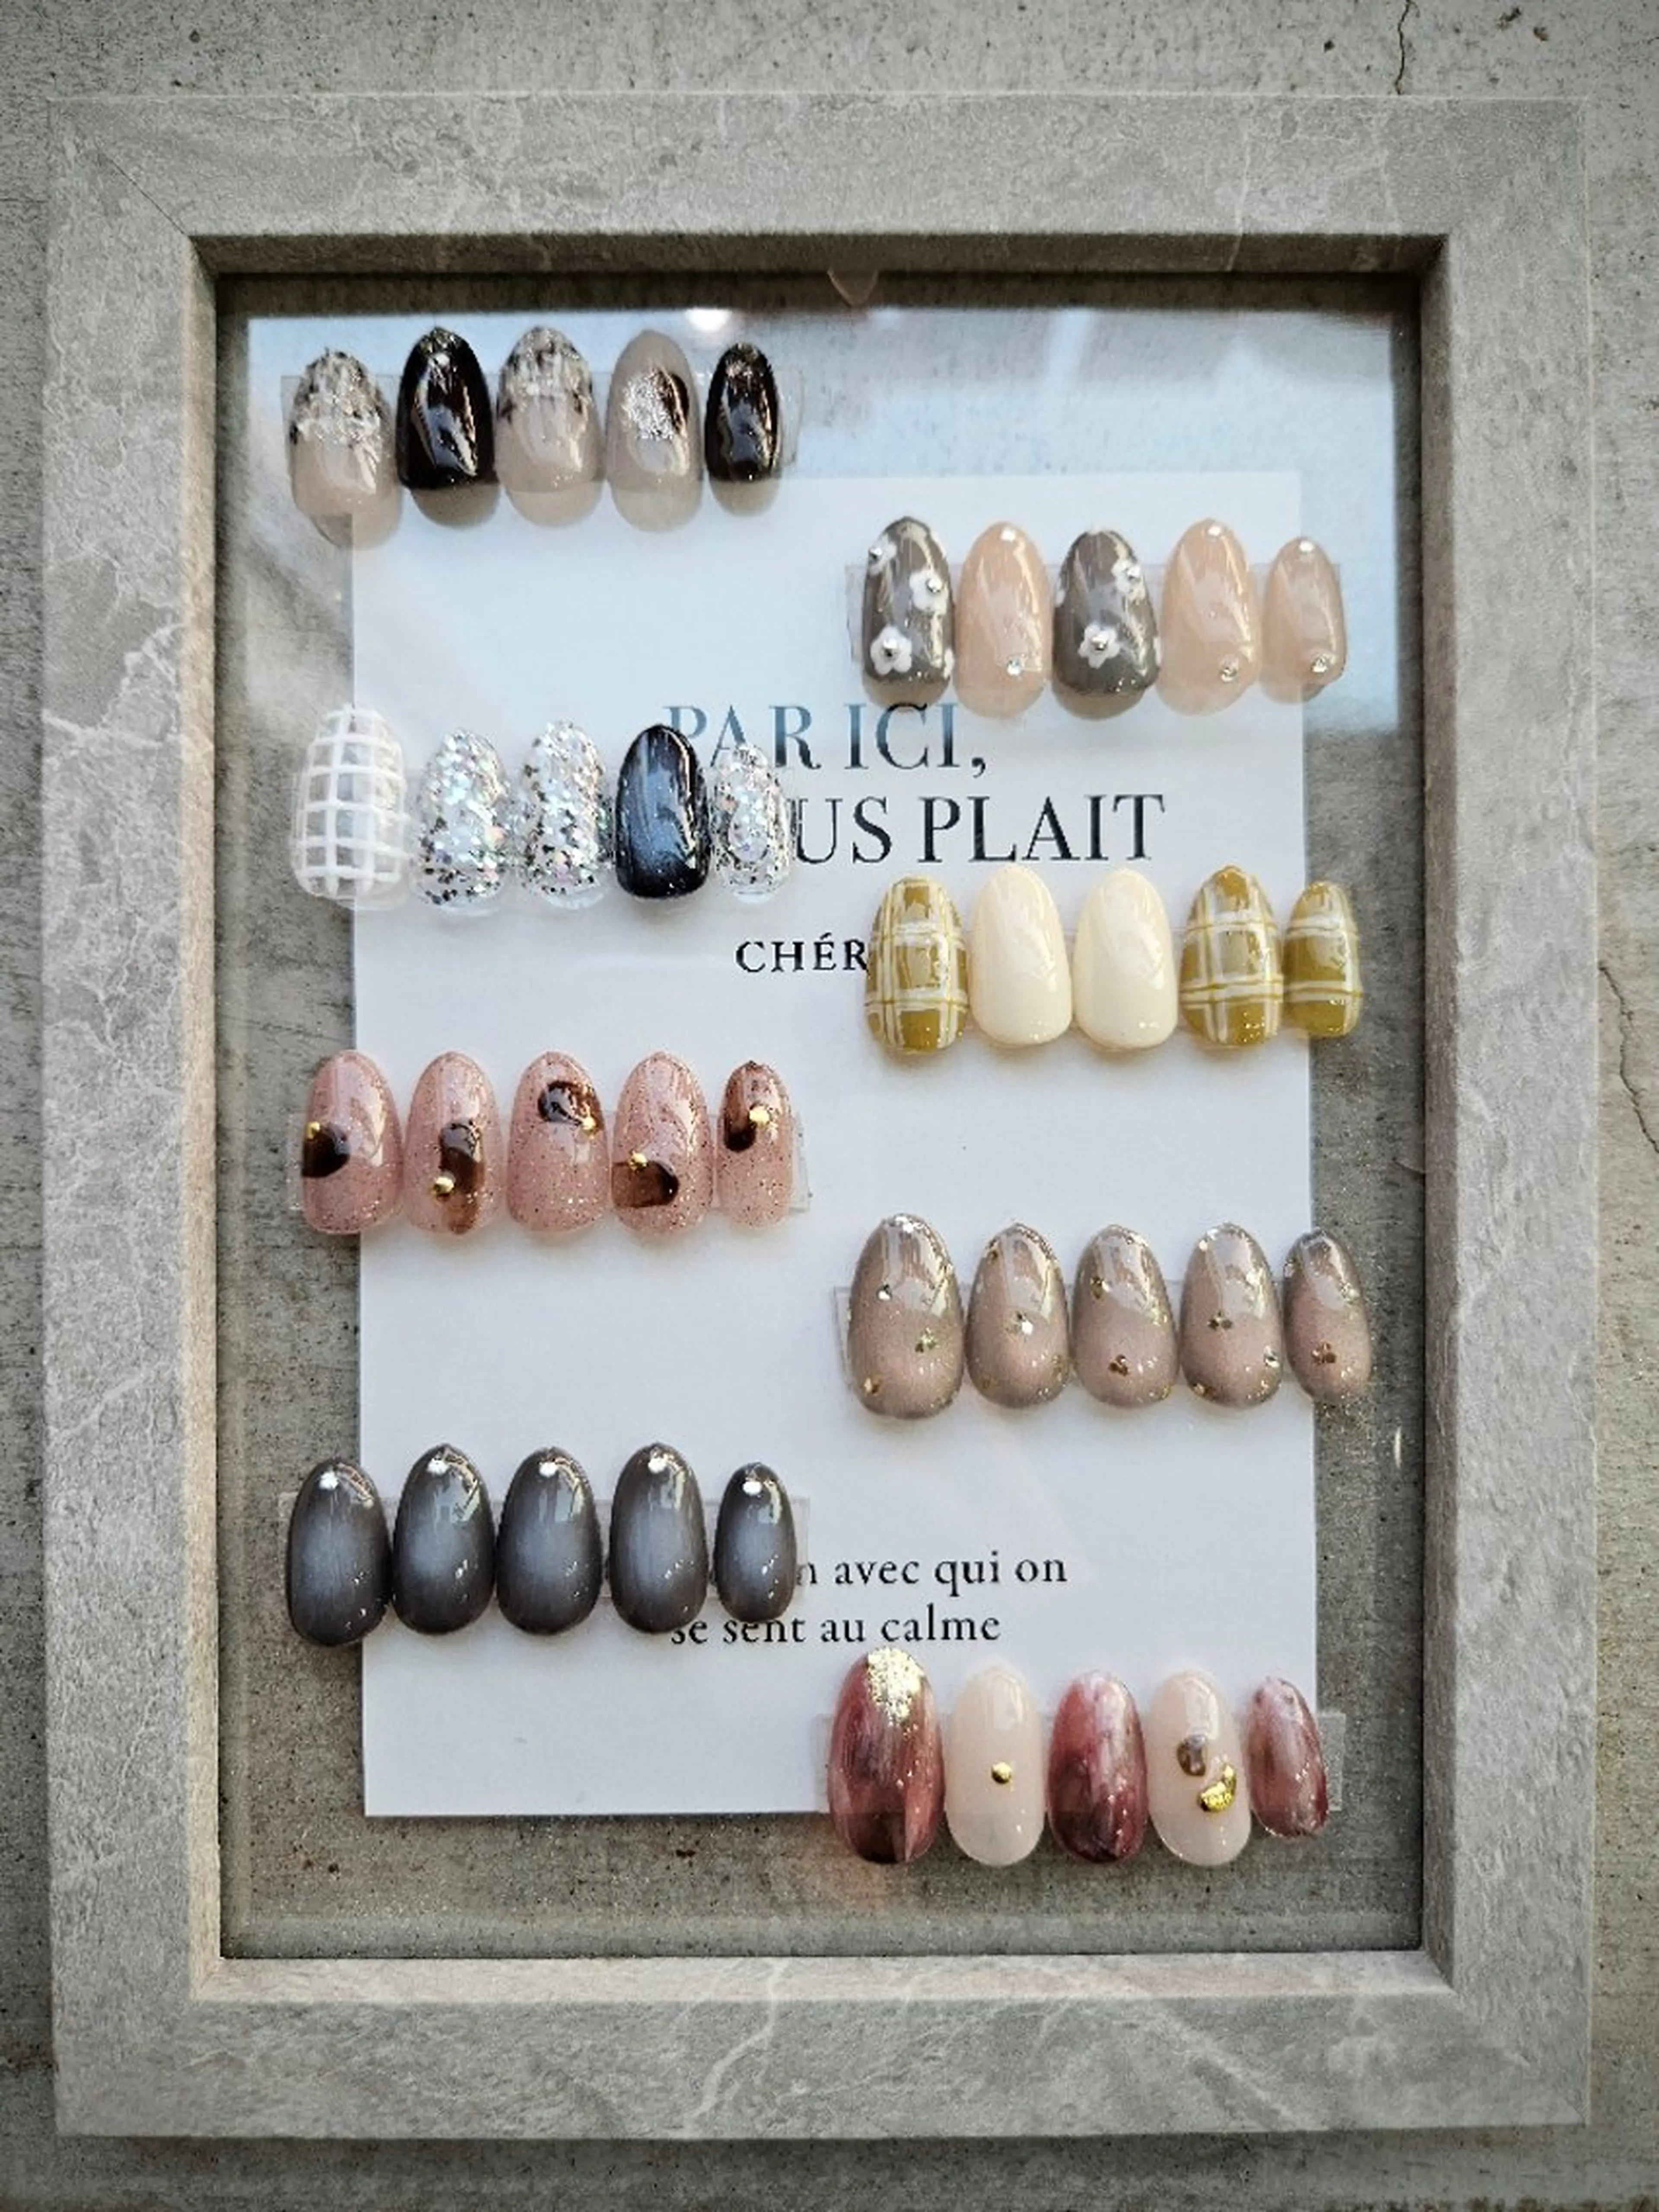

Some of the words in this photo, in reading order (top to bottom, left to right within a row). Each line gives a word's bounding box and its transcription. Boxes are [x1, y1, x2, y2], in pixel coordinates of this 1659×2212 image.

[843, 703, 987, 777] ICI,
[918, 794, 1166, 862] PLAIT
[735, 932, 870, 976] CHÉR
[835, 1559, 919, 1585] avec
[934, 1550, 1000, 1597] qui
[1015, 1558, 1068, 1583] on
[723, 1617, 807, 1644] sent
[821, 1618, 865, 1643] au
[880, 1603, 1001, 1642] calme
